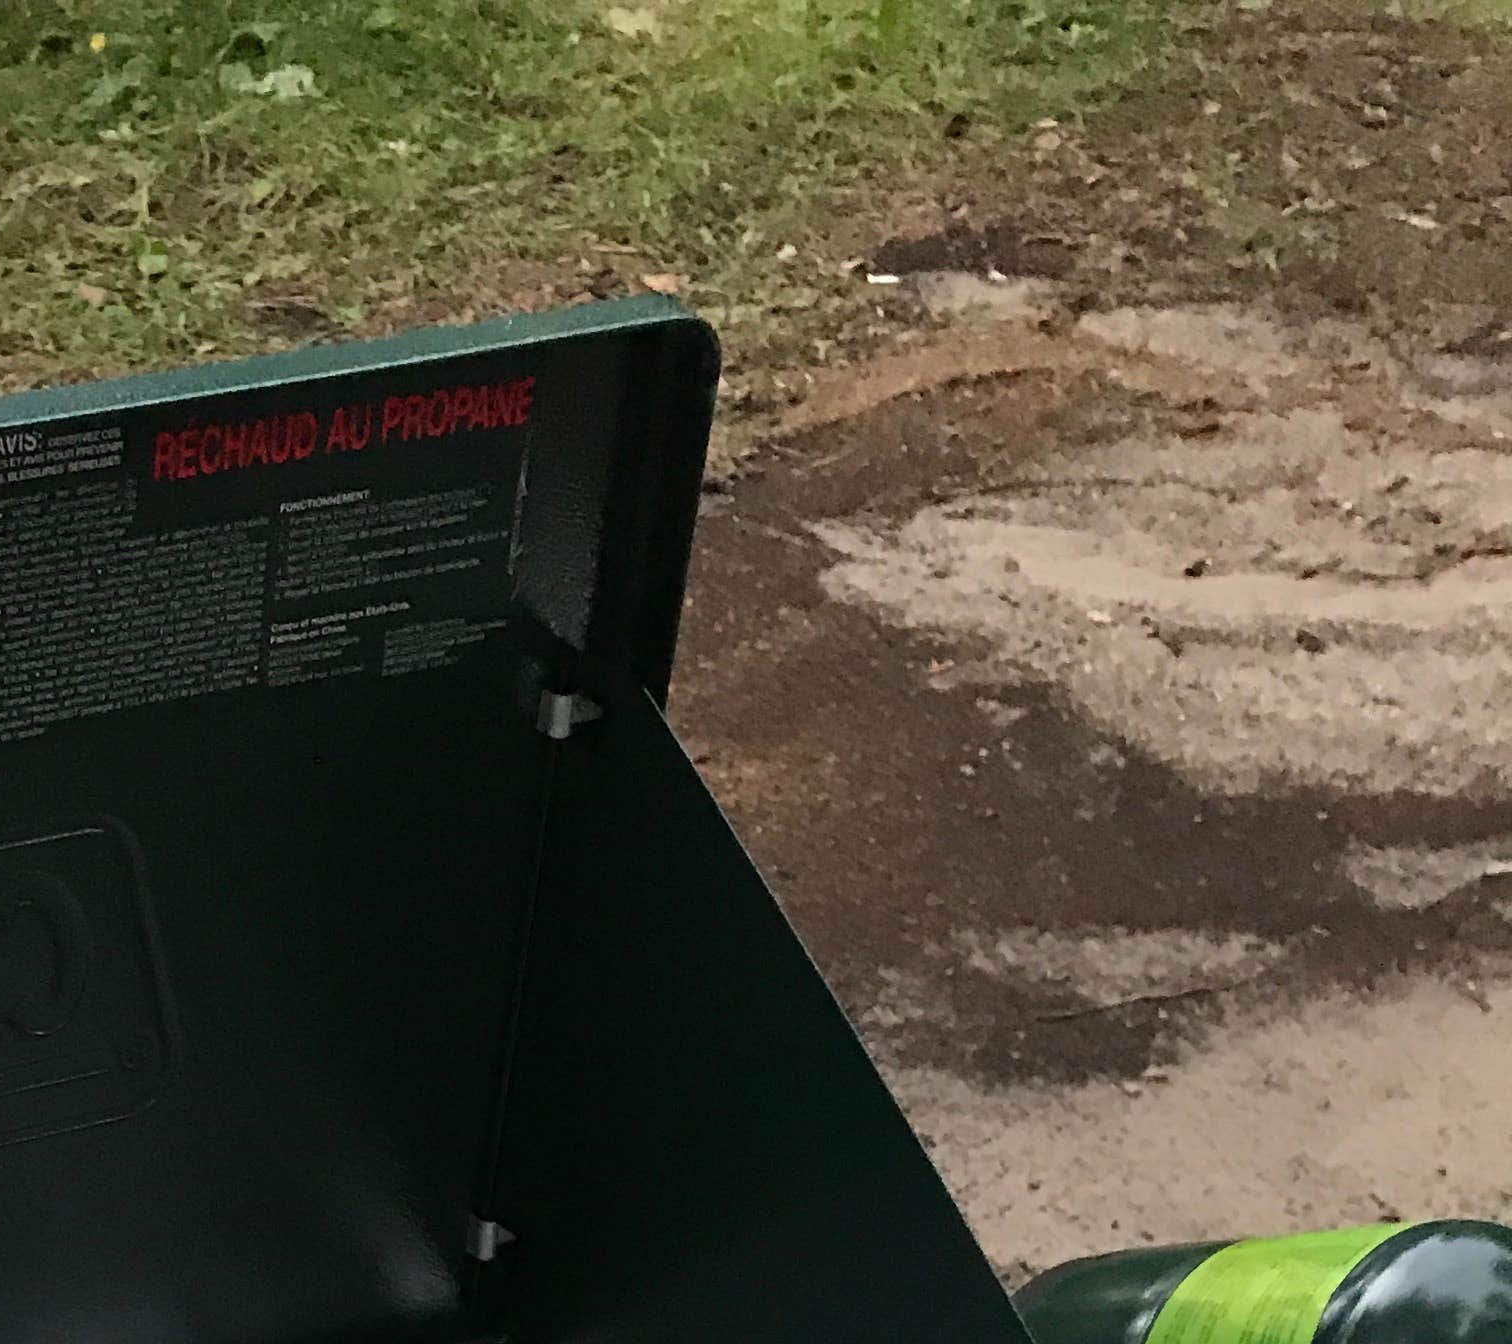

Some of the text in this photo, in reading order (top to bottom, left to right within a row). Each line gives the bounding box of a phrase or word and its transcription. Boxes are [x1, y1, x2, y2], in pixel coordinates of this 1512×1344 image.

[152, 376, 537, 481] RÉCHAUD AU PROPANE
